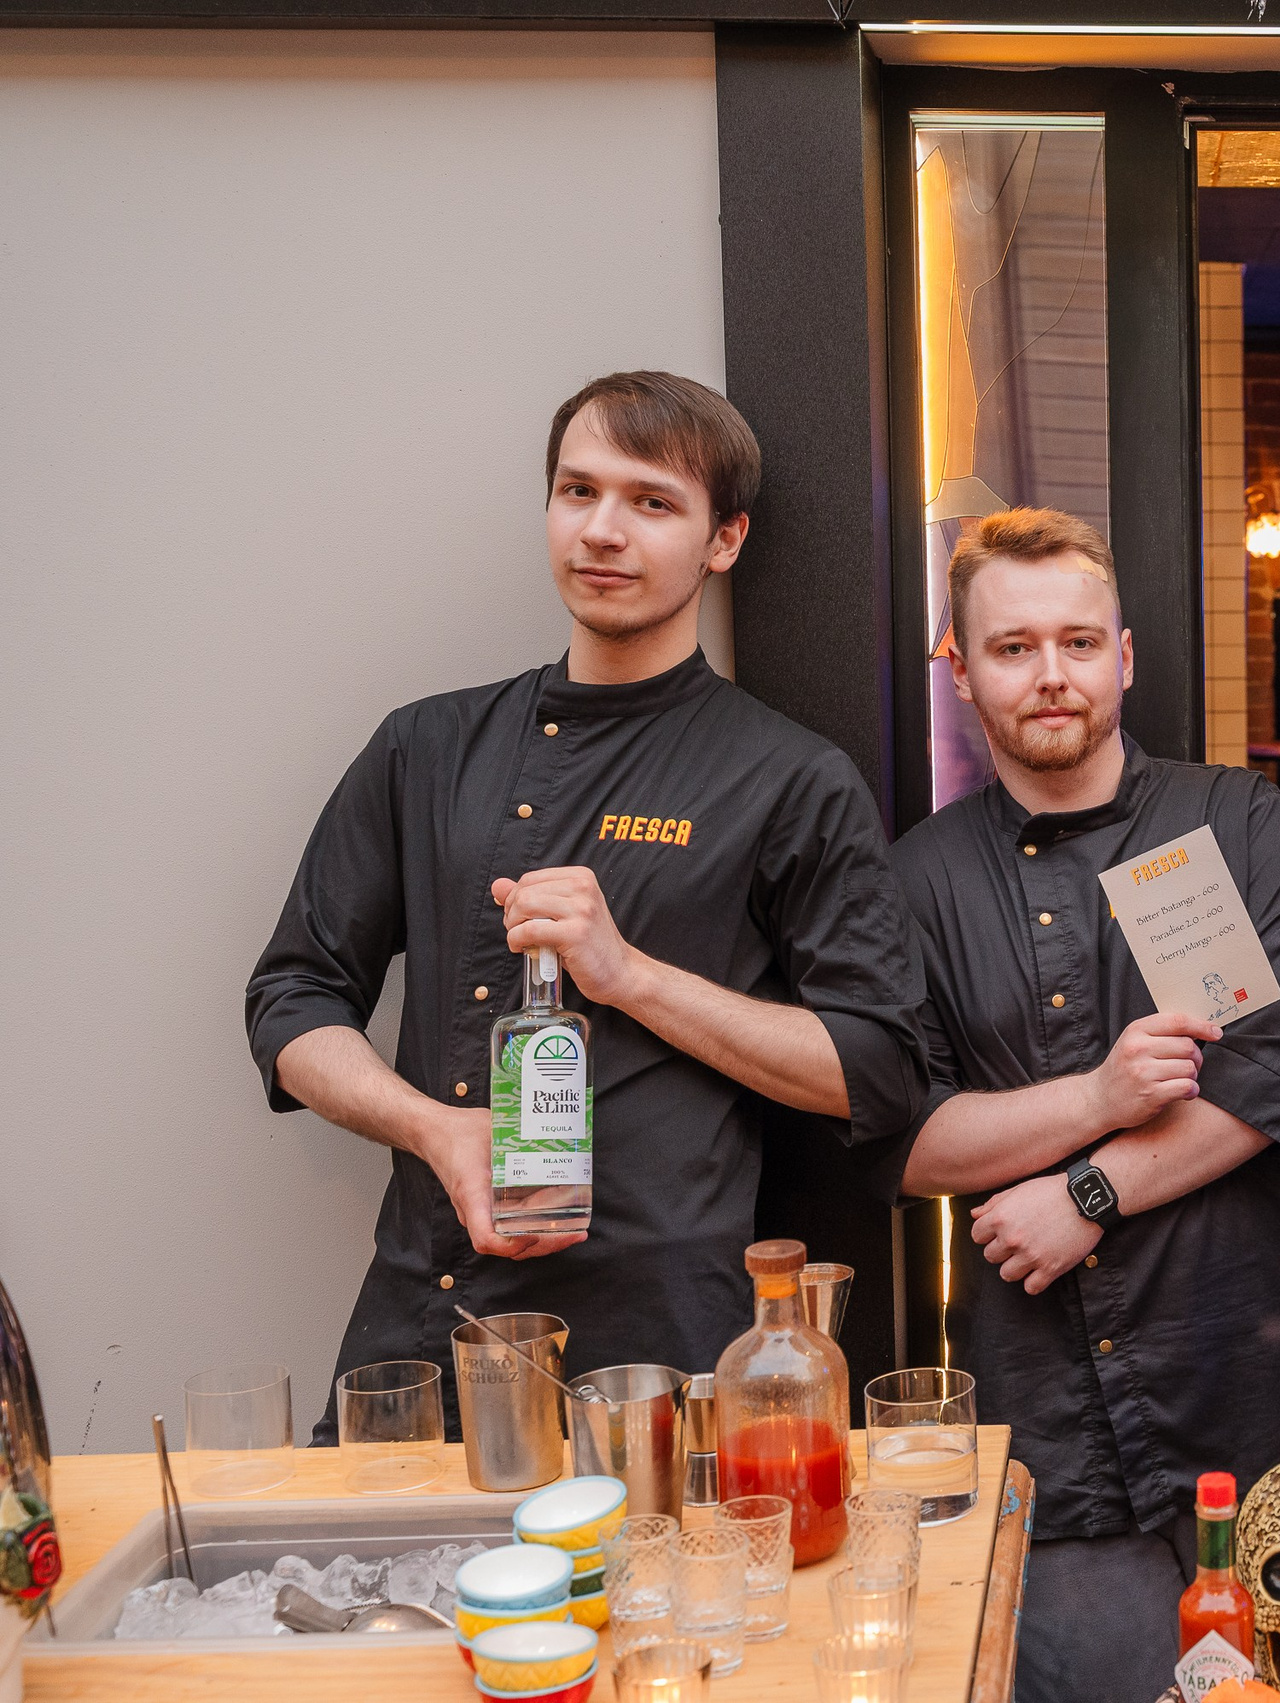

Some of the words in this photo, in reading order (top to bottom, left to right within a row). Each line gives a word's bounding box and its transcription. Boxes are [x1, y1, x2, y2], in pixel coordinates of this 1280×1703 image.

[599, 814, 692, 847] FRESCA
[1131, 847, 1190, 886] FRESCA
[1136, 911, 1161, 926] Bitter
[1160, 895, 1196, 915] Batanga
[1202, 883, 1219, 896] 600
[1150, 925, 1185, 943] Paradise
[1185, 916, 1200, 928] 2.0
[1207, 905, 1223, 918] 600
[1156, 948, 1186, 965] Cherry
[1219, 923, 1236, 937] 600
[532, 1101, 580, 1113] &Lime
[533, 1089, 580, 1102] Pacific
[461, 1370, 520, 1384] SCHULZ
[1181, 1668, 1248, 1691] TABAO
